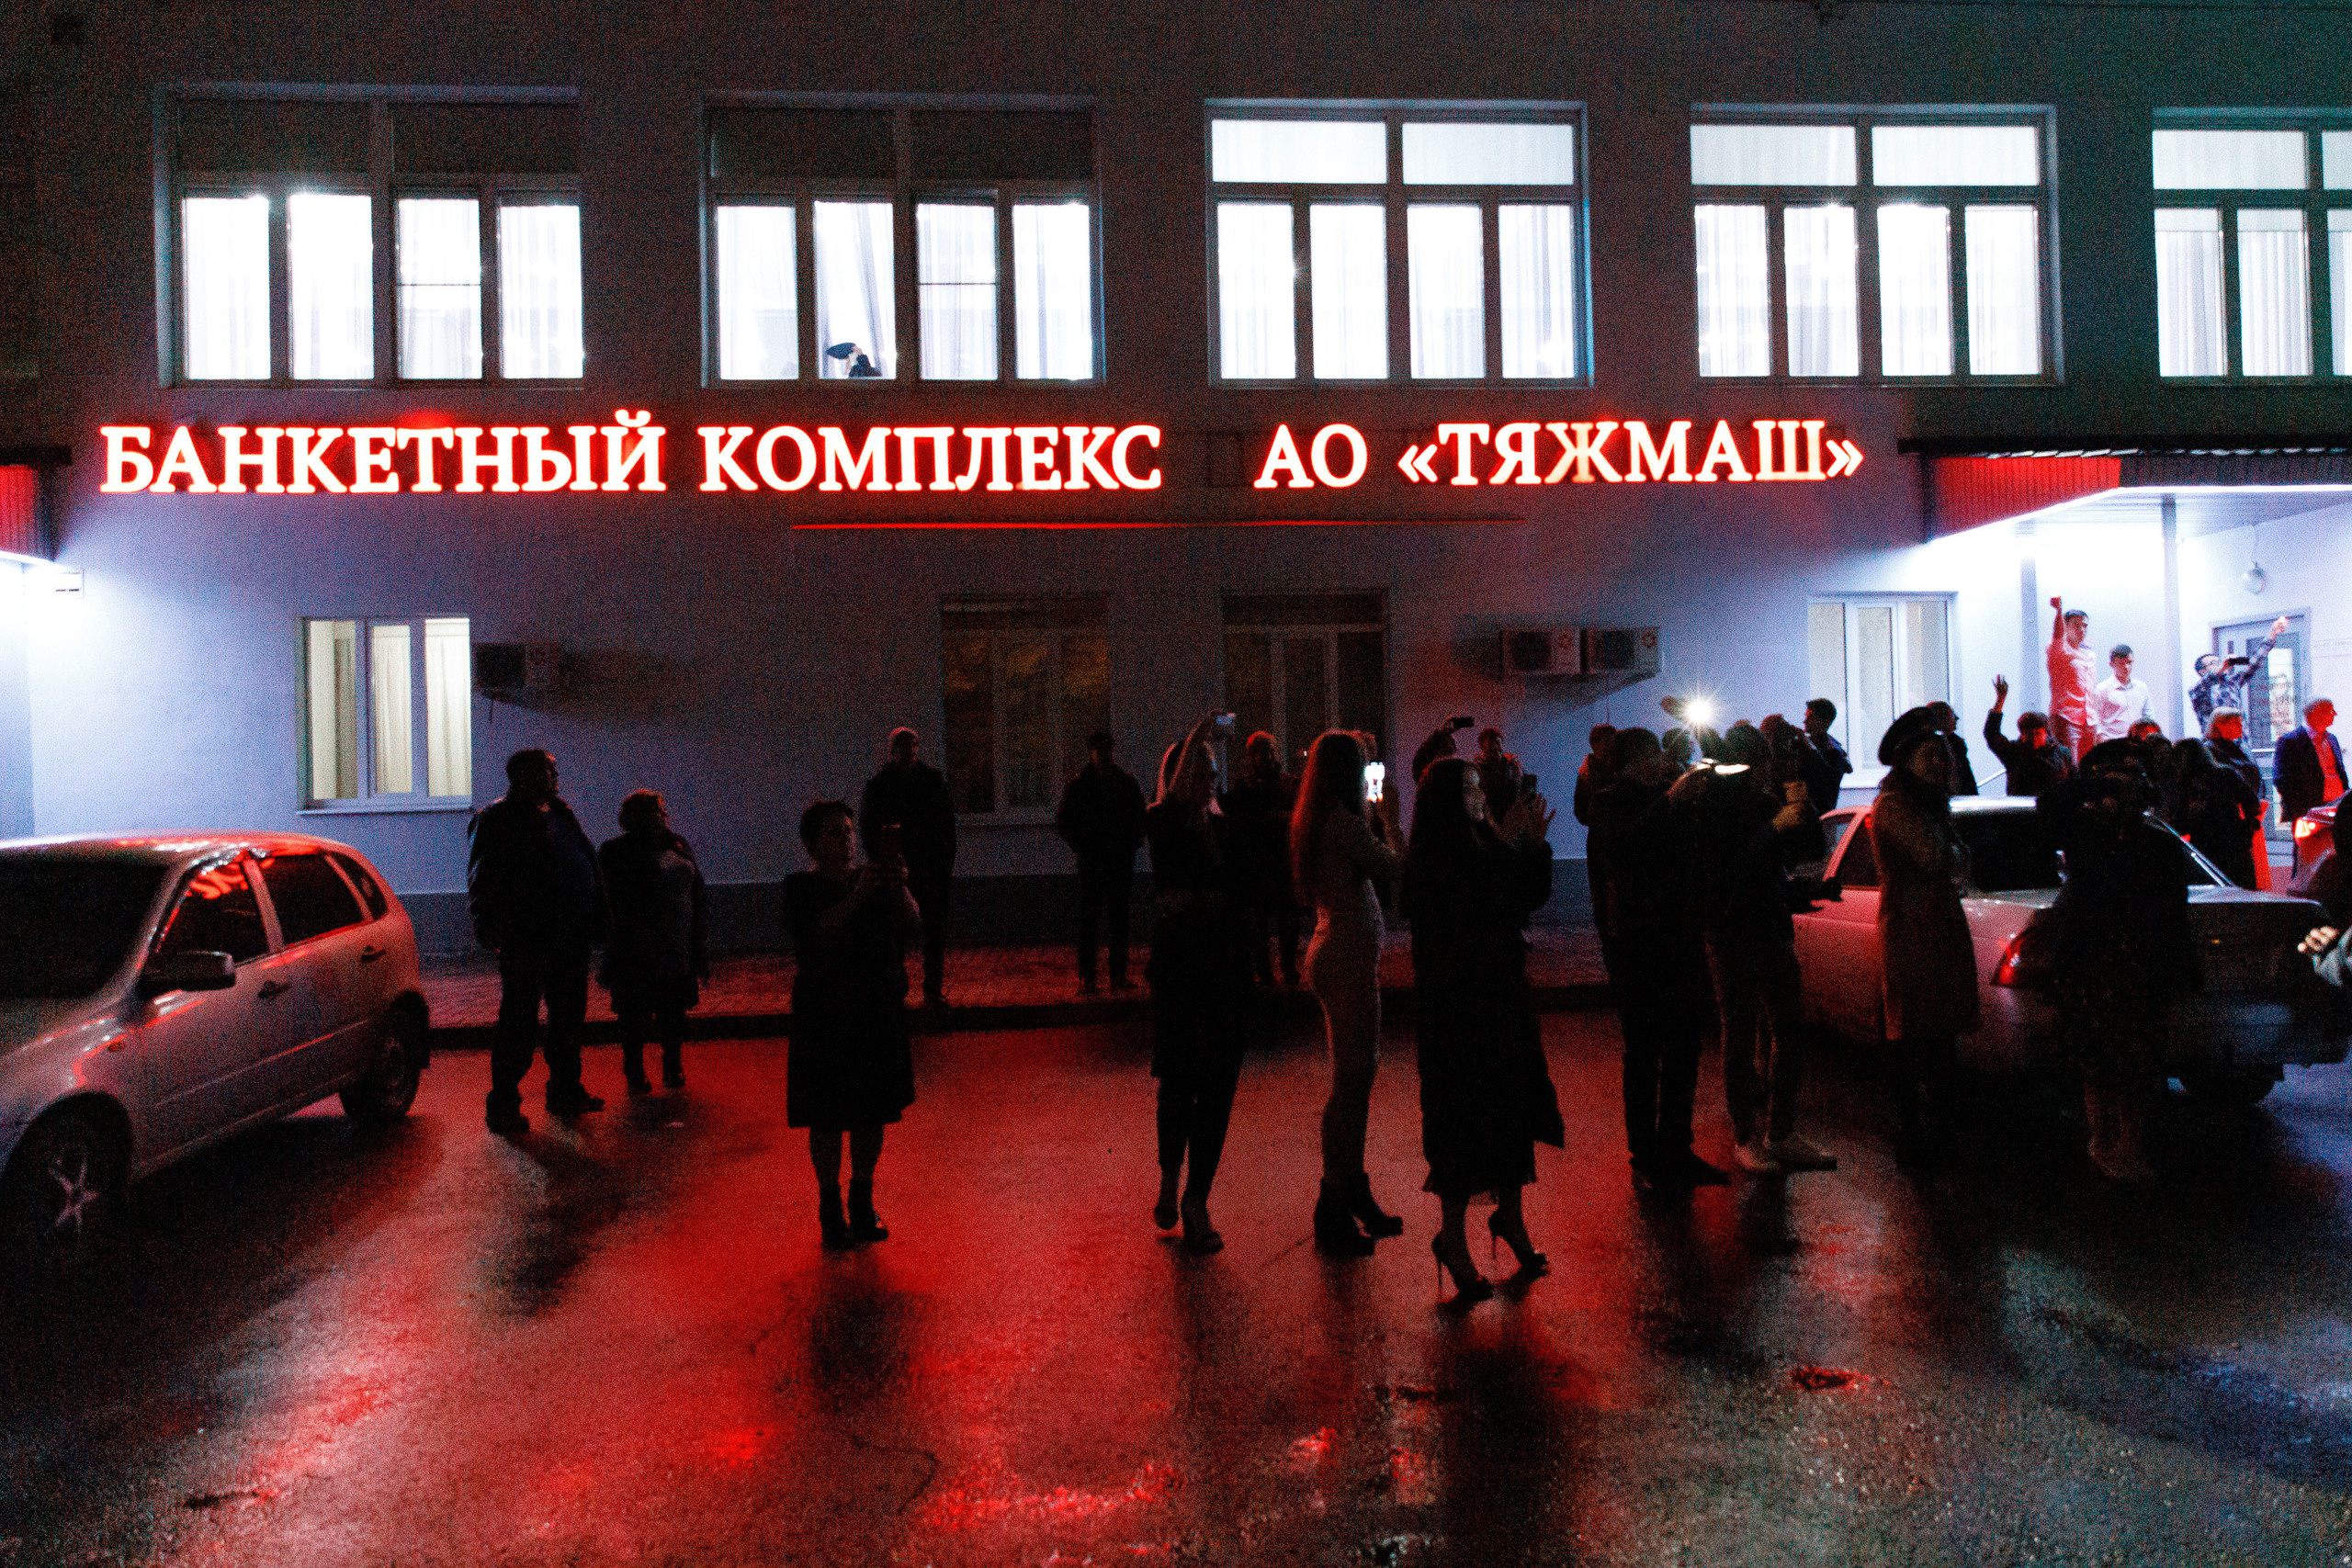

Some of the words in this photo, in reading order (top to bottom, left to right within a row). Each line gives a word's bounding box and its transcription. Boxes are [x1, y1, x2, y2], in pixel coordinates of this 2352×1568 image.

[98, 409, 667, 494] БАНКЕТНЫЙ
[696, 424, 1163, 492] КОМПЛЕКС
[1254, 423, 1368, 489] АО
[1397, 419, 1864, 486] «ТЯЖМАШ»
